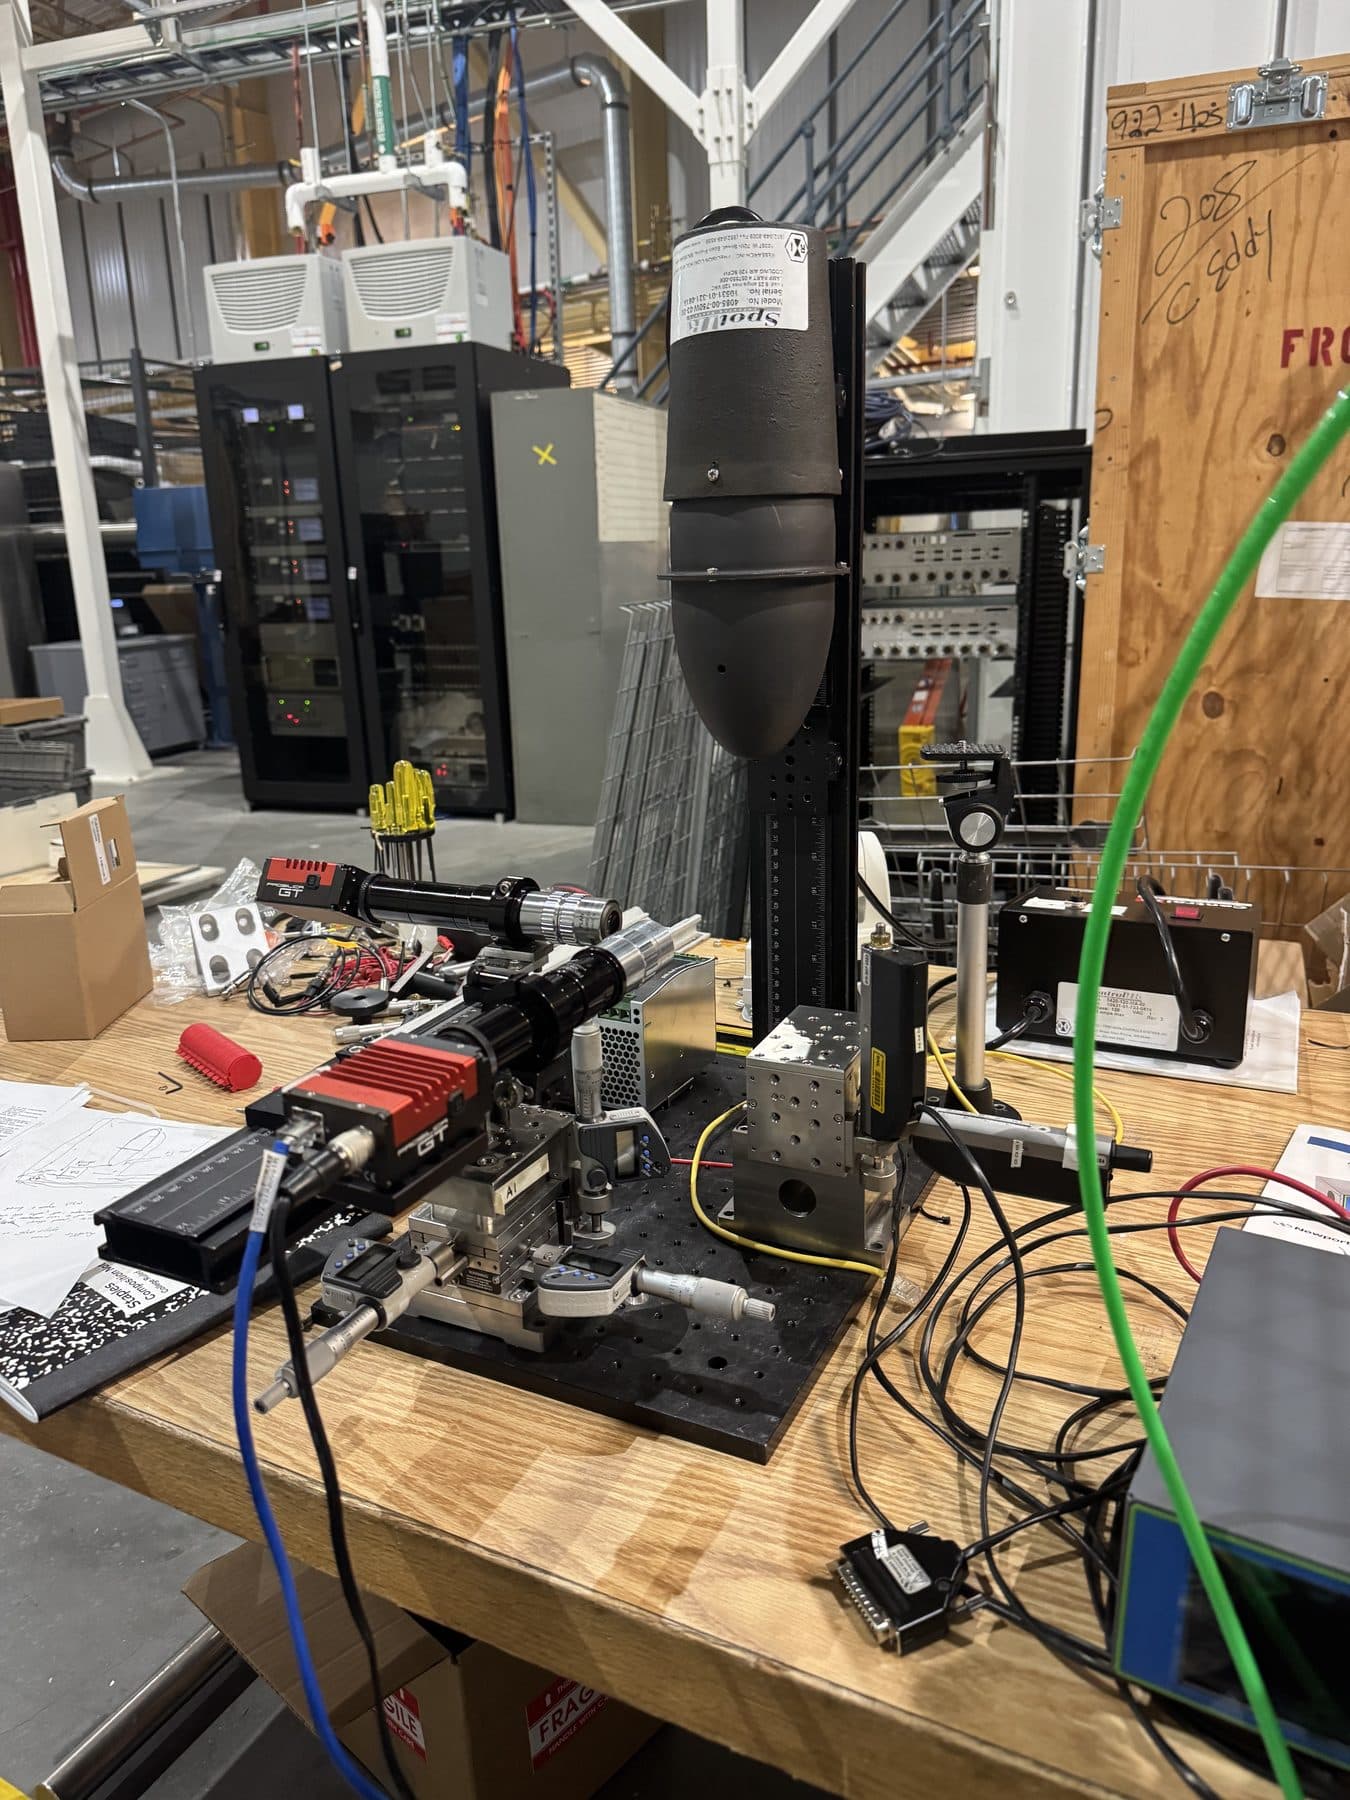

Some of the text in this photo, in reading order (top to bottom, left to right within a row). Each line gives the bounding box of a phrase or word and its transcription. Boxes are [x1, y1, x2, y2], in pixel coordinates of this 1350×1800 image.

[1111, 104, 1163, 139] 922
[1155, 160, 1257, 277] 208
[278, 887, 304, 898] GT
[417, 1123, 449, 1157] GT
[104, 1282, 141, 1309] Staples
[111, 1268, 156, 1300] Composition
